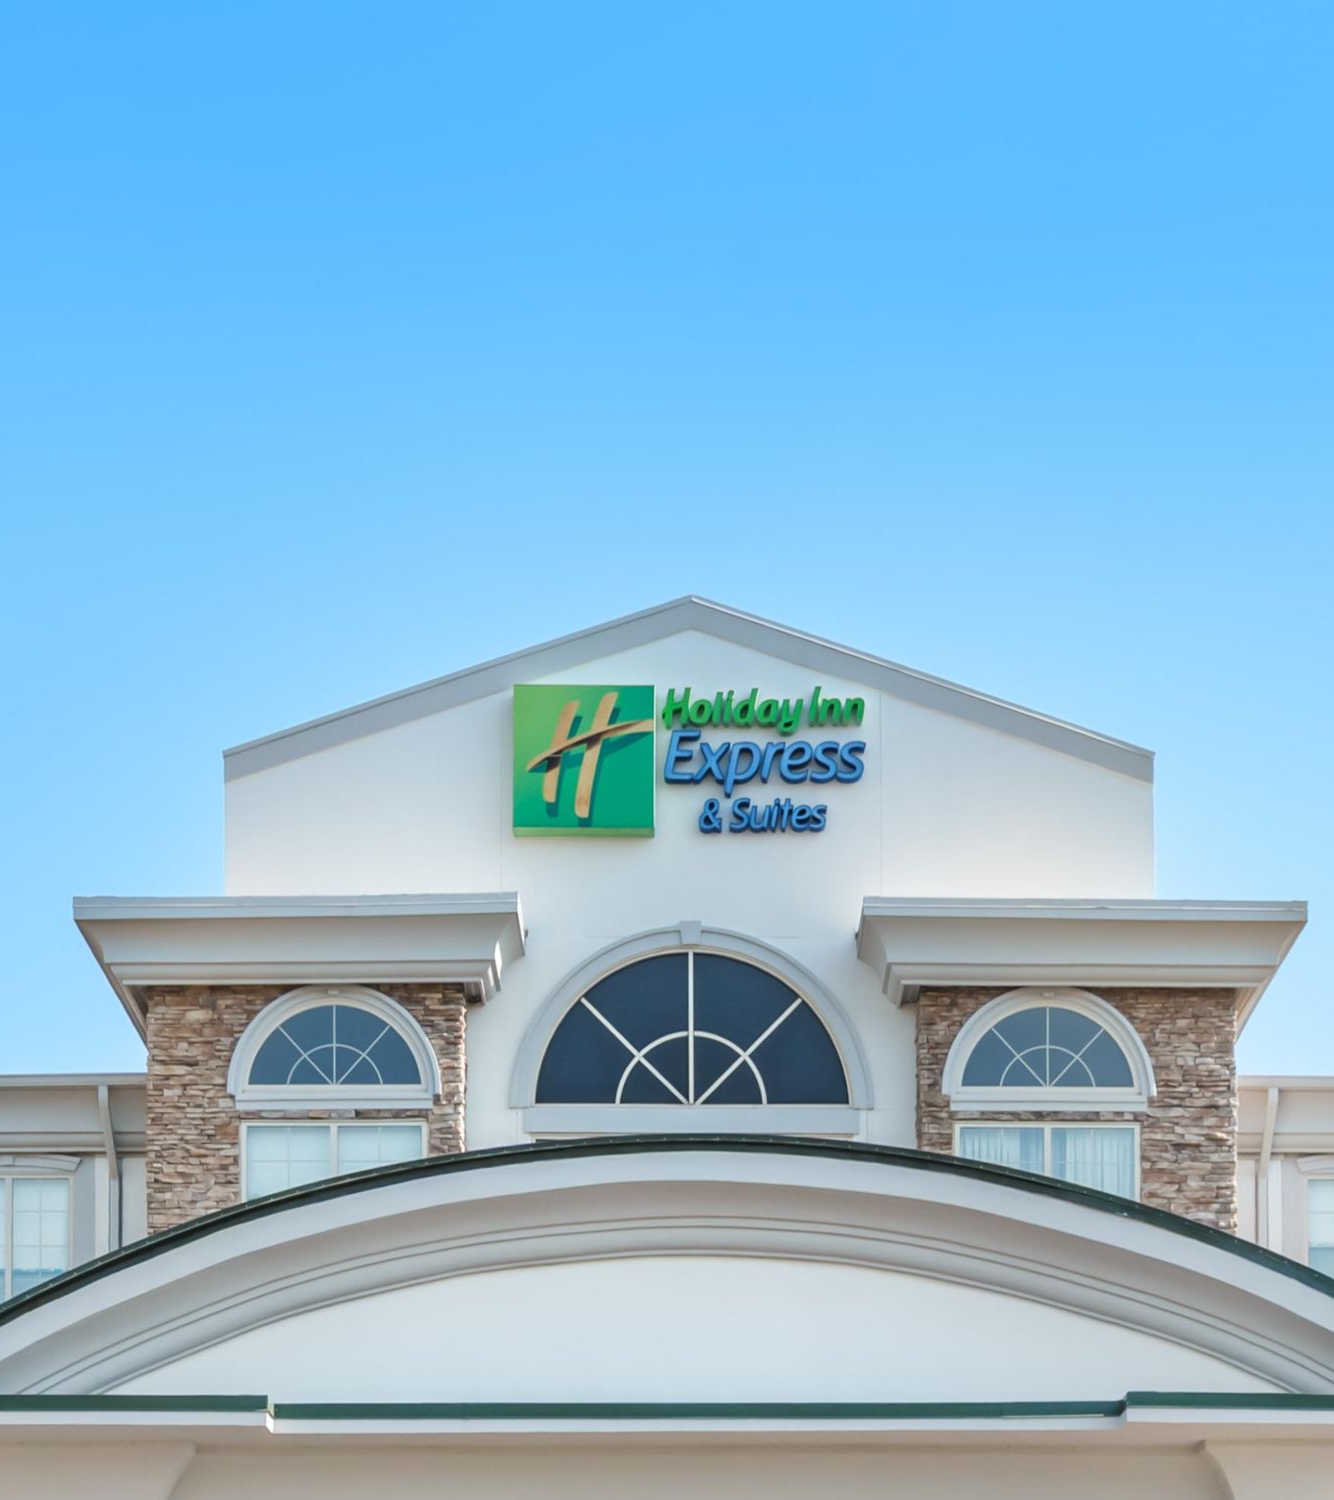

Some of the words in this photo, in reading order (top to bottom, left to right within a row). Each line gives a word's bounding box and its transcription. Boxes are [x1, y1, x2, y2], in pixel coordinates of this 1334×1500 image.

[662, 687, 802, 736] Holiday
[809, 686, 866, 726] Inn
[663, 729, 867, 798] Express
[698, 797, 723, 833] &
[729, 797, 828, 833] Suites
